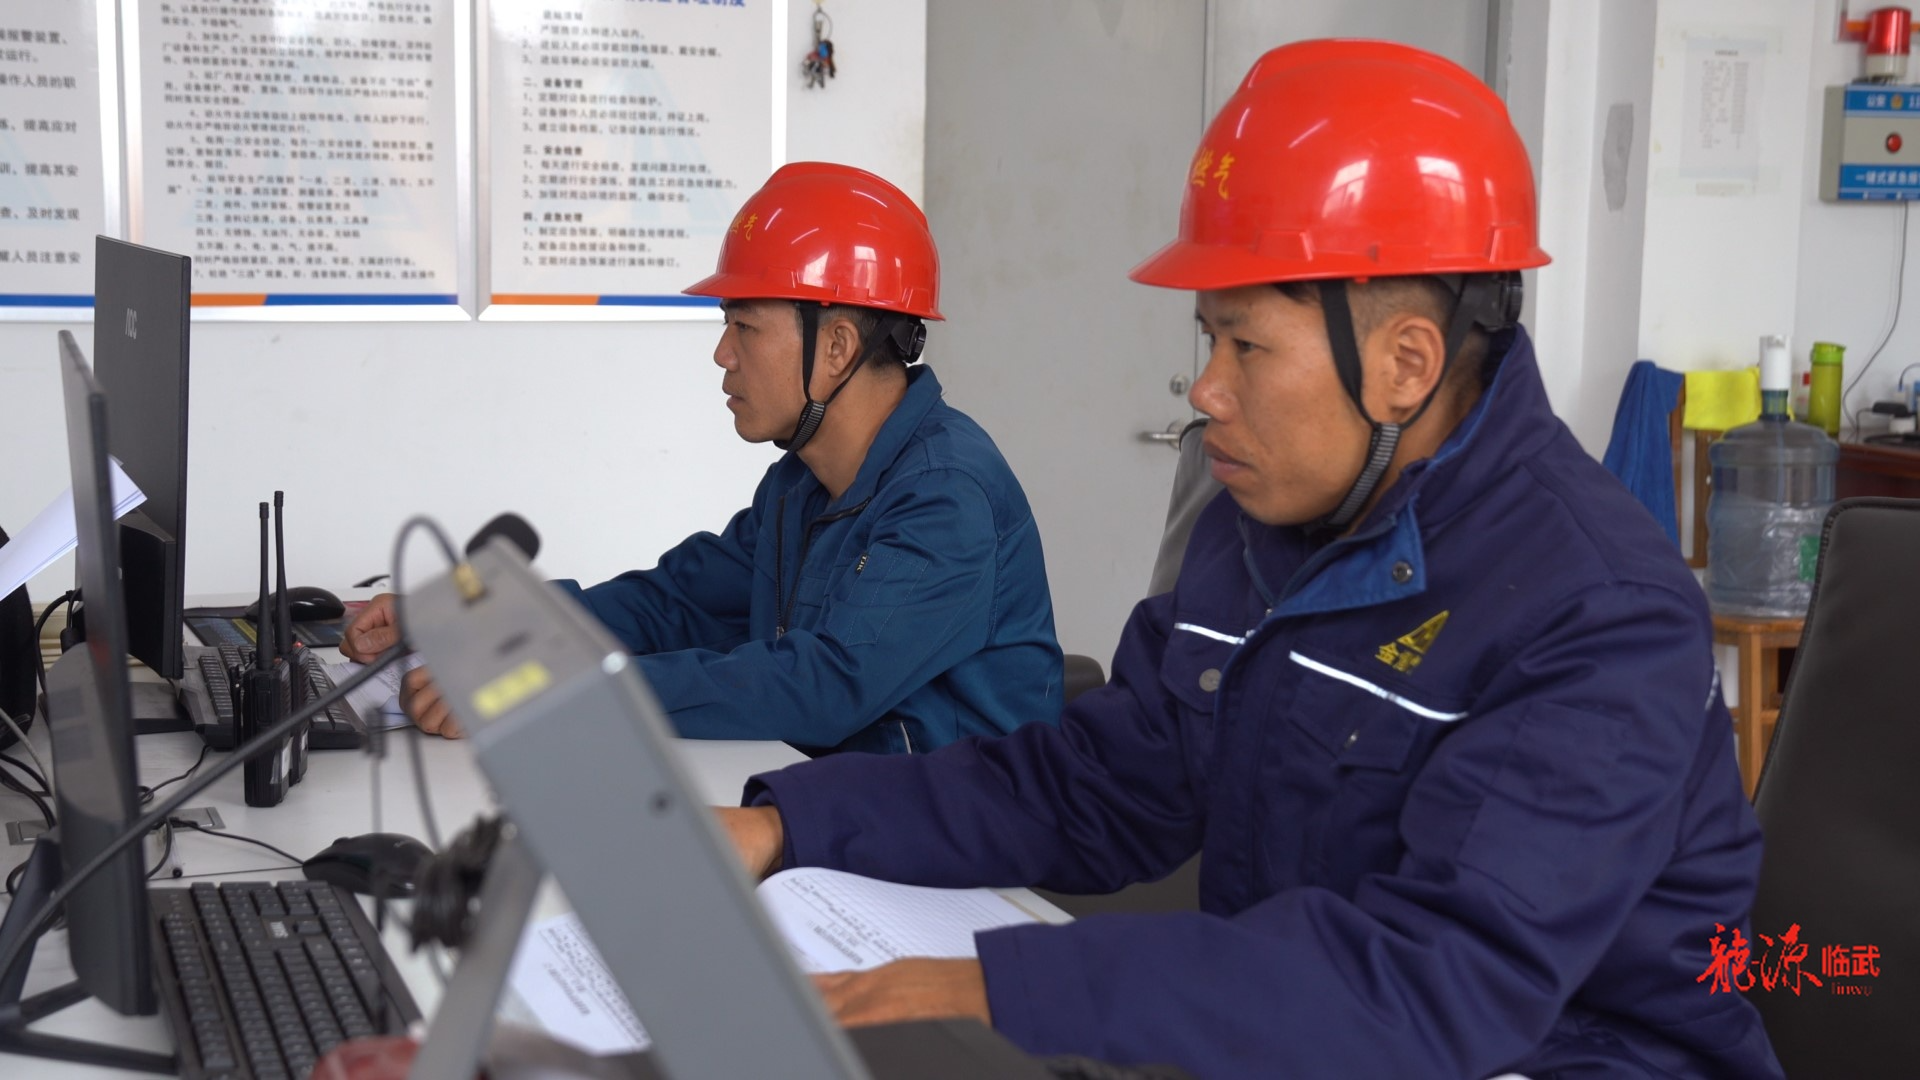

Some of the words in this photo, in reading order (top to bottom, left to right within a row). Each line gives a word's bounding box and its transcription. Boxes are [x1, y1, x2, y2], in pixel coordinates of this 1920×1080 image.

[524, 77, 583, 89] 二、设备管理
[523, 145, 583, 156] 三、安全检查
